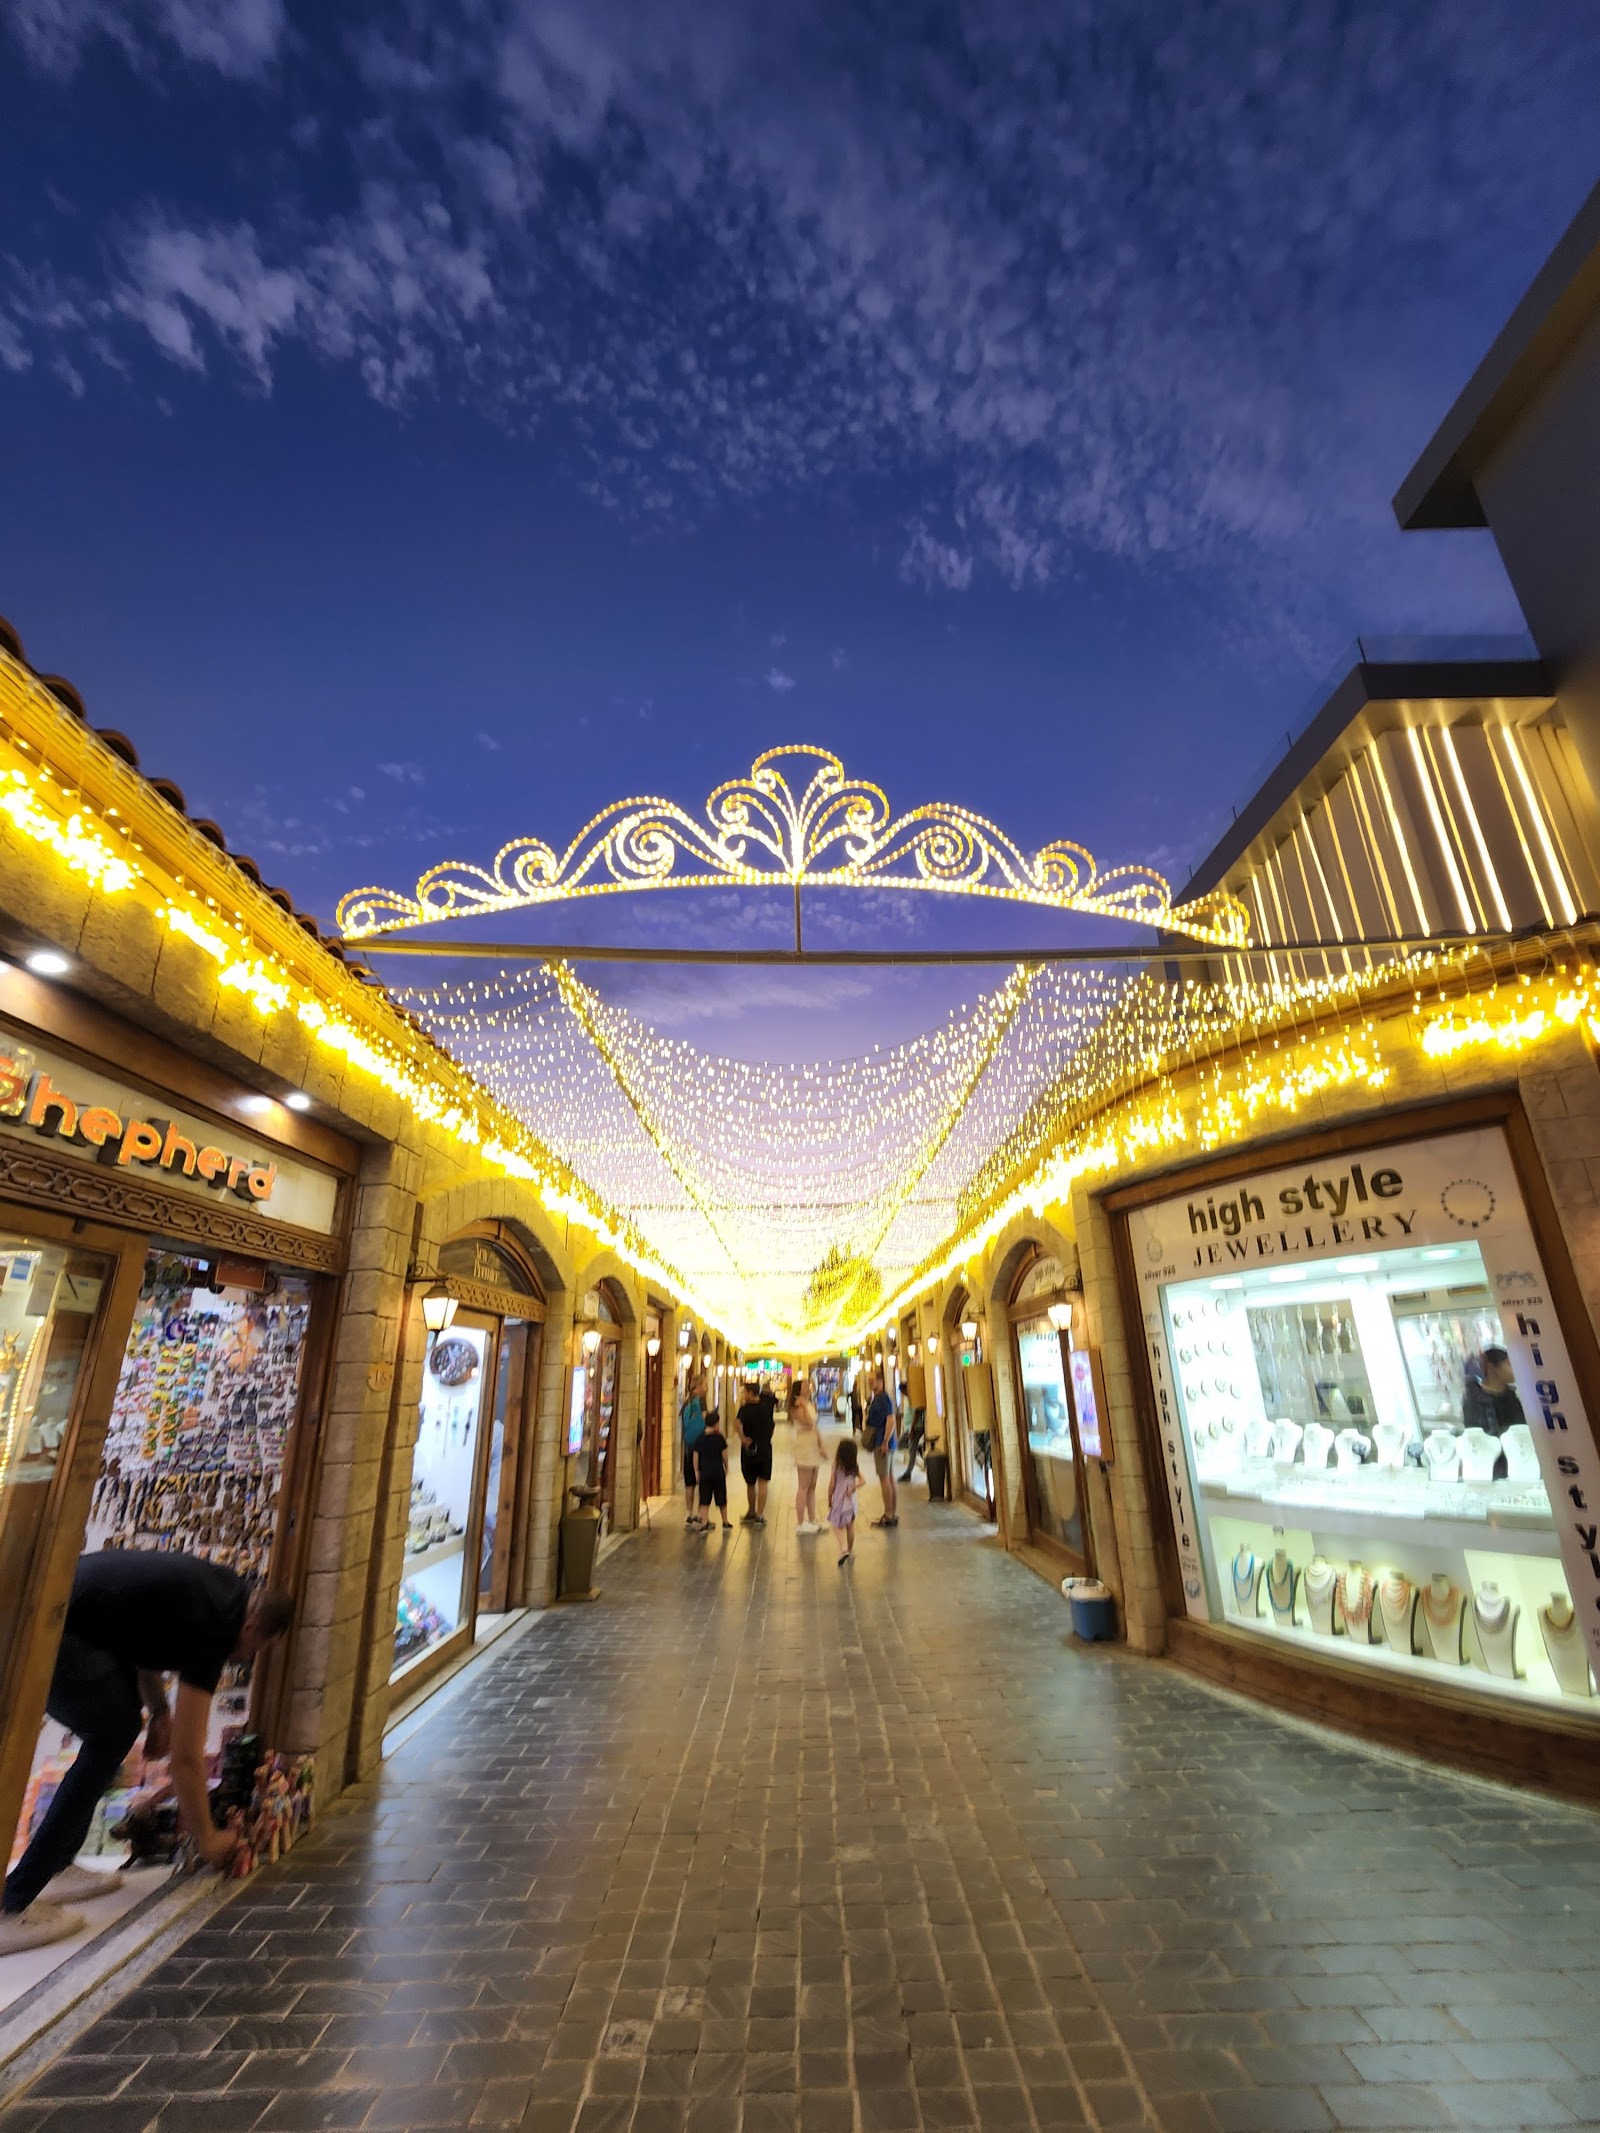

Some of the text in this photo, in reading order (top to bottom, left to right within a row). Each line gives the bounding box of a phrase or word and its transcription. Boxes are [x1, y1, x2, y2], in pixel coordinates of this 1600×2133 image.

[1187, 1163, 1405, 1236] high style
[1193, 1209, 1418, 1268] JEWELLERY
[1501, 1296, 1543, 1307] silver 925
[1152, 1342, 1171, 1425] high
[1167, 1440, 1191, 1549] style
[1516, 1312, 1600, 1612] high styl
